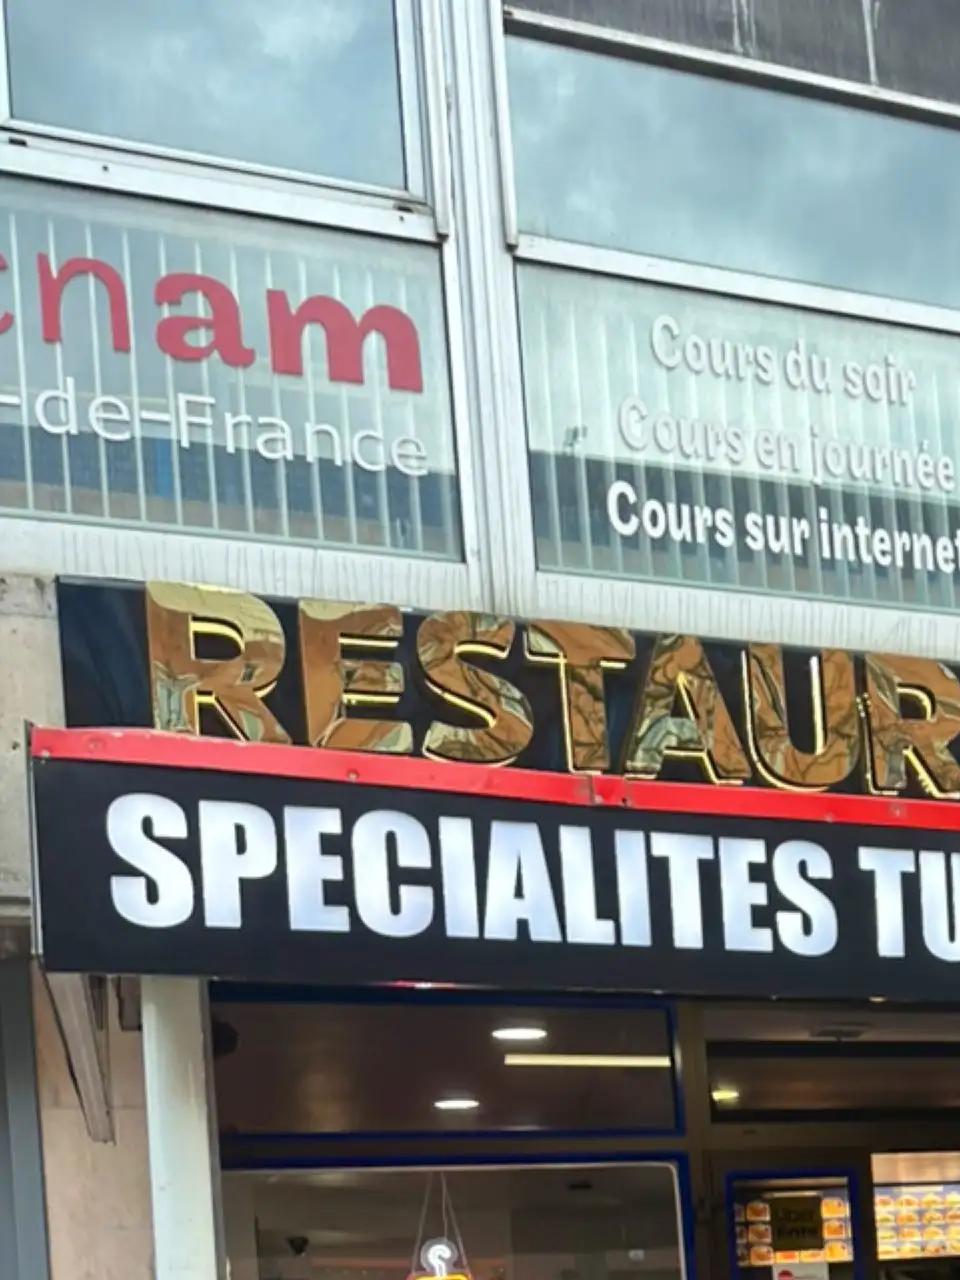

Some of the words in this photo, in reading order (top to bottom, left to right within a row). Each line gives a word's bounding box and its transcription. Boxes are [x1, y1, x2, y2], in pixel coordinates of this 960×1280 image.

[652, 315, 775, 385] Cours
[784, 339, 831, 394] du
[843, 353, 916, 405] soir
[619, 396, 743, 465] Cours
[754, 429, 800, 471] en
[810, 424, 955, 492] journée
[607, 481, 735, 548] Cours
[744, 508, 809, 555] sur
[105, 793, 838, 957] SPECIALITES
